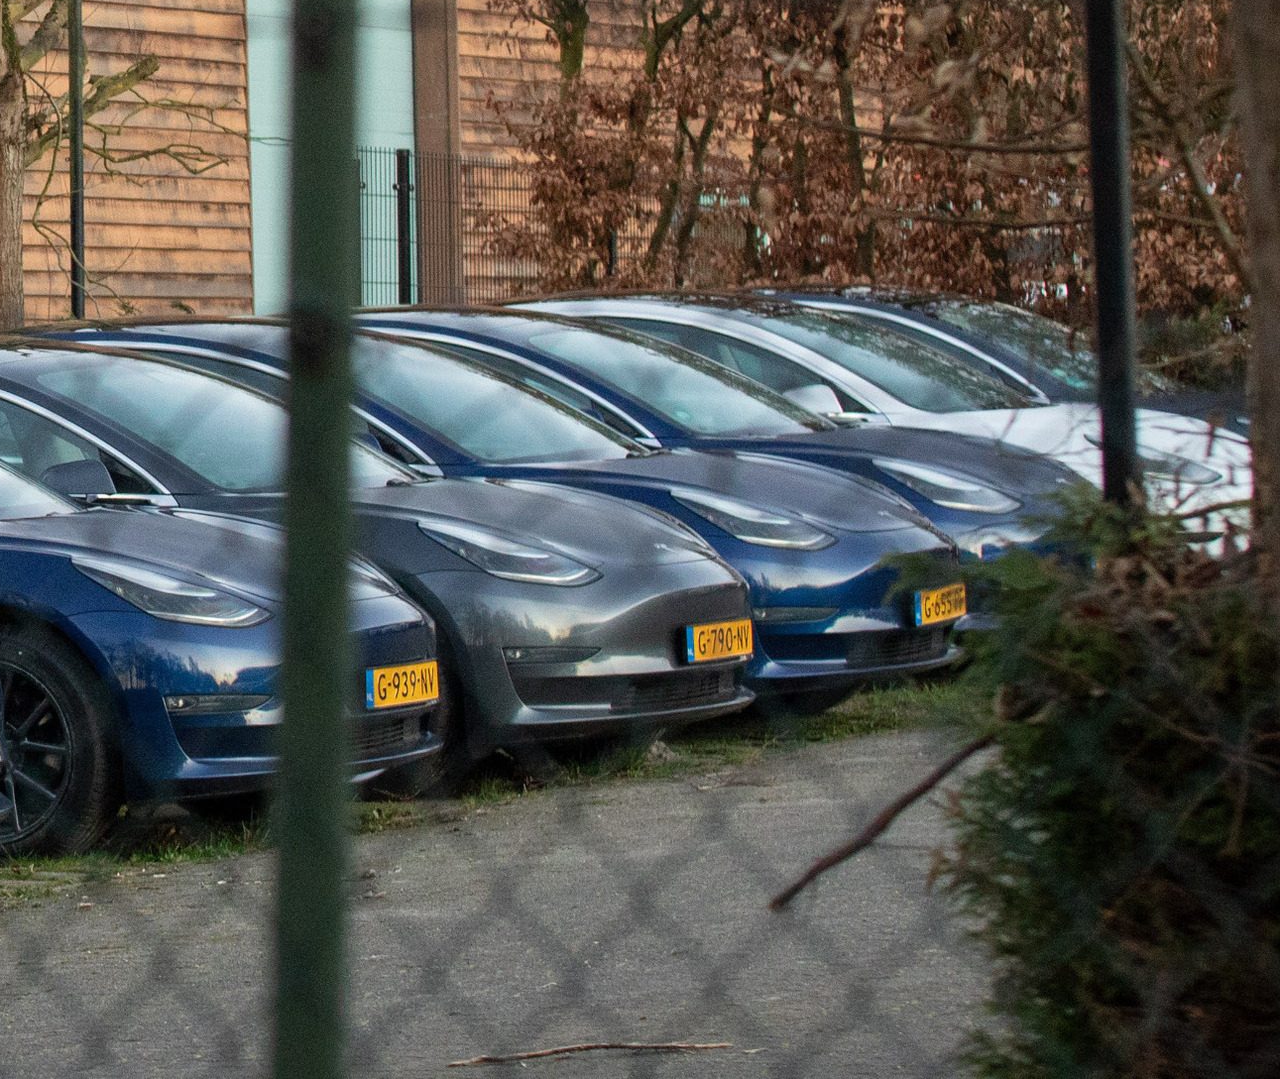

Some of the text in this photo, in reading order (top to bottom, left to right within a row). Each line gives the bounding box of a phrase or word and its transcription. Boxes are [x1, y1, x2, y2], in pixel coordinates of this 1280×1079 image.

[925, 587, 964, 618] G-655
[698, 624, 749, 655] G-790-NV
[378, 667, 434, 700] G-939-NV
